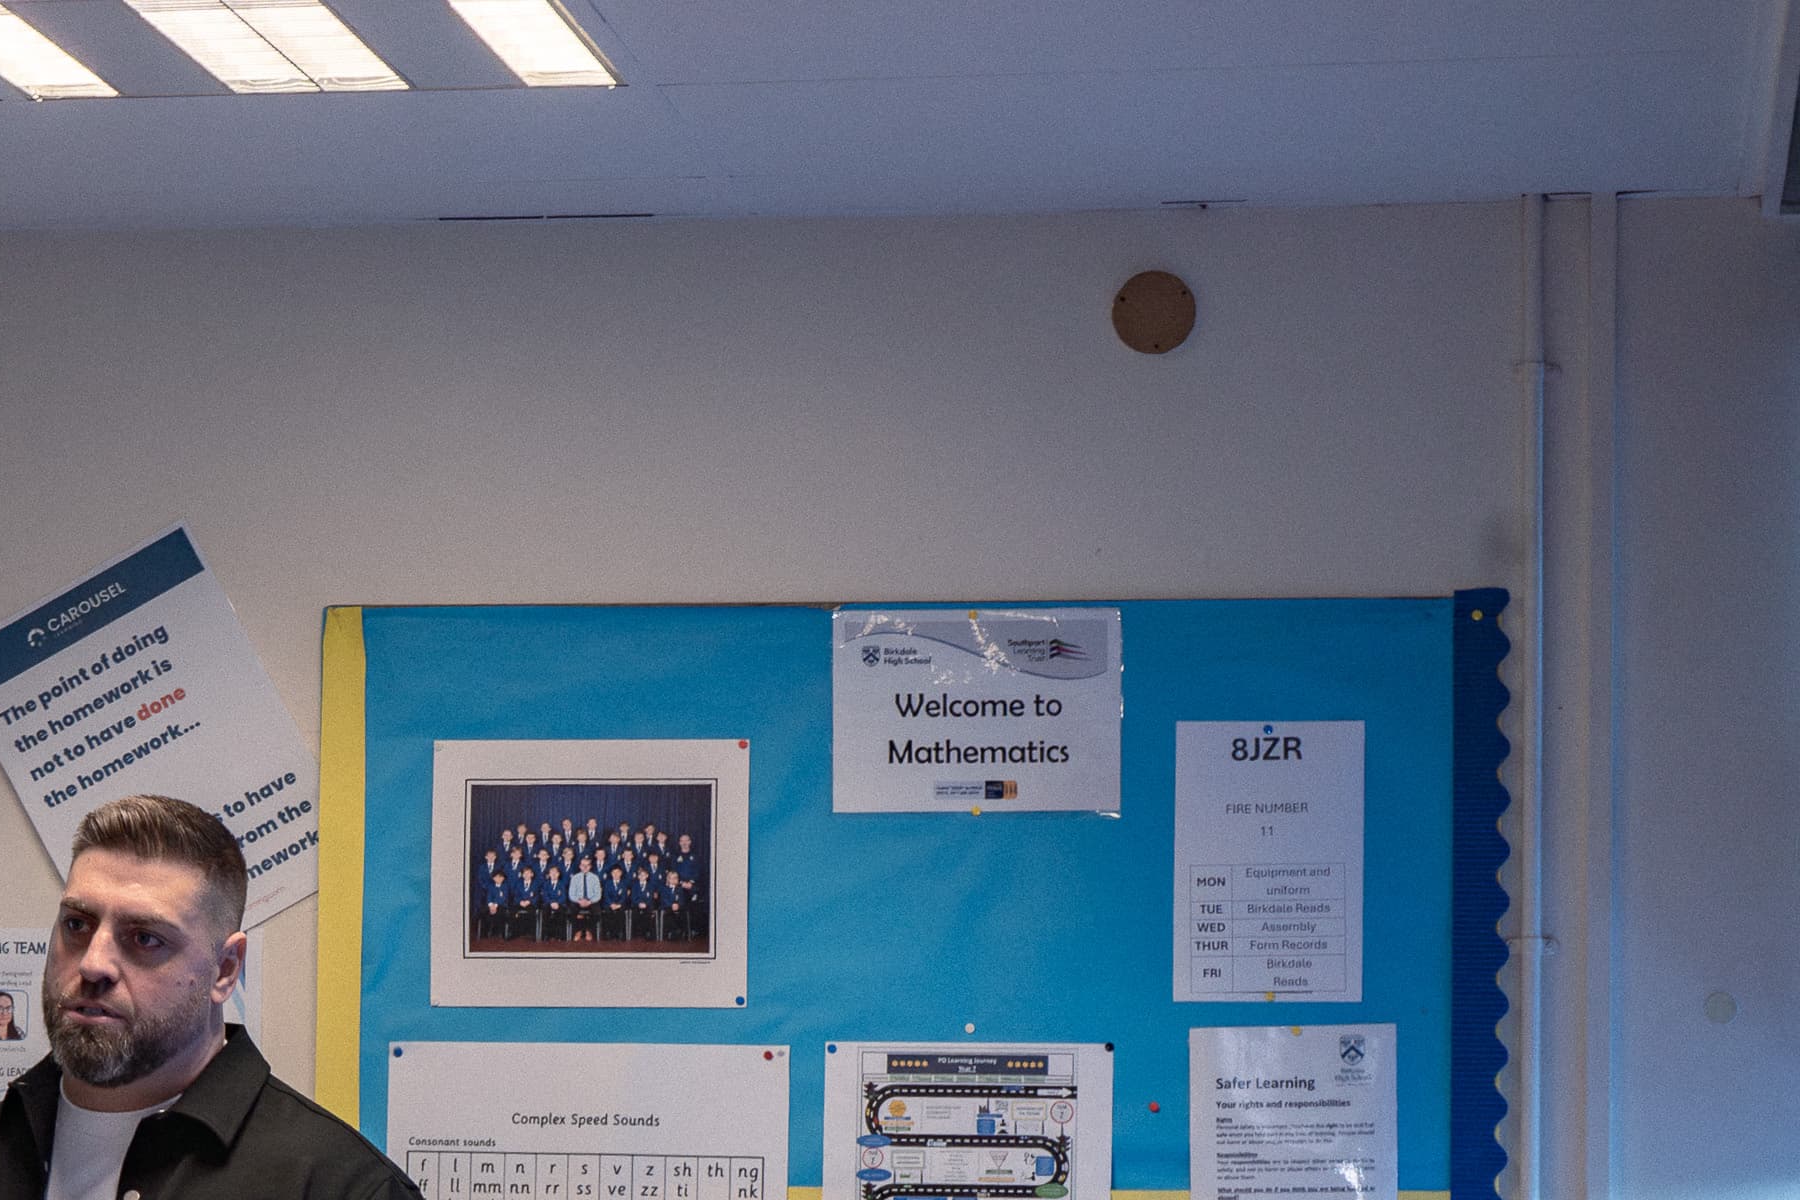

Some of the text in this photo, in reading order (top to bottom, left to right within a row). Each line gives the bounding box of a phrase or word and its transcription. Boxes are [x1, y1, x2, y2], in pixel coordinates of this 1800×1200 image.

[47, 581, 127, 632] CAROUSEL
[1007, 639, 1045, 648] Southport
[883, 647, 917, 656] Birkdale
[883, 656, 932, 666] High School
[0, 625, 169, 726] The point of doing
[14, 658, 172, 753] the homework is
[895, 693, 1062, 717] Welcome to
[30, 688, 186, 781] not to have done
[888, 740, 1069, 764] Mathematics
[1231, 737, 1303, 761] 8JZR
[43, 721, 201, 808] the homework...
[223, 801, 245, 818] to
[244, 772, 296, 806] have
[1226, 803, 1309, 815] FIRE NUMBER
[236, 800, 312, 848] rom the
[1260, 826, 1274, 836] 11
[1245, 867, 1331, 880] Equipment and
[1196, 877, 1226, 887] MON
[1266, 885, 1310, 895] uniform
[1200, 903, 1331, 914] TUE Birkdale Reads
[1197, 921, 1316, 933] WED Assembly
[13, 942, 47, 955] TEAM
[1195, 940, 1327, 950] THUR Form Records
[1266, 959, 1312, 969] Birkdale
[1203, 968, 1221, 978] FRI
[1273, 977, 1308, 986] Reads
[1216, 1077, 1315, 1091] Safer Learning
[1216, 1101, 1236, 1109] Your
[1238, 1101, 1264, 1110] rights
[1284, 1099, 1351, 1110] responsibilities
[512, 1113, 660, 1129] Complex Speed Sounds
[409, 1136, 496, 1147] Consonant sounds
[481, 1162, 758, 1182] m n r s v z sh th ng
[473, 1183, 501, 1194] mm
[510, 1183, 530, 1194] nn
[545, 1184, 560, 1194] rr
[576, 1184, 592, 1195] ss
[608, 1185, 626, 1196] ve
[640, 1185, 658, 1196] zz
[677, 1183, 688, 1197] ti
[738, 1184, 758, 1198] nk
